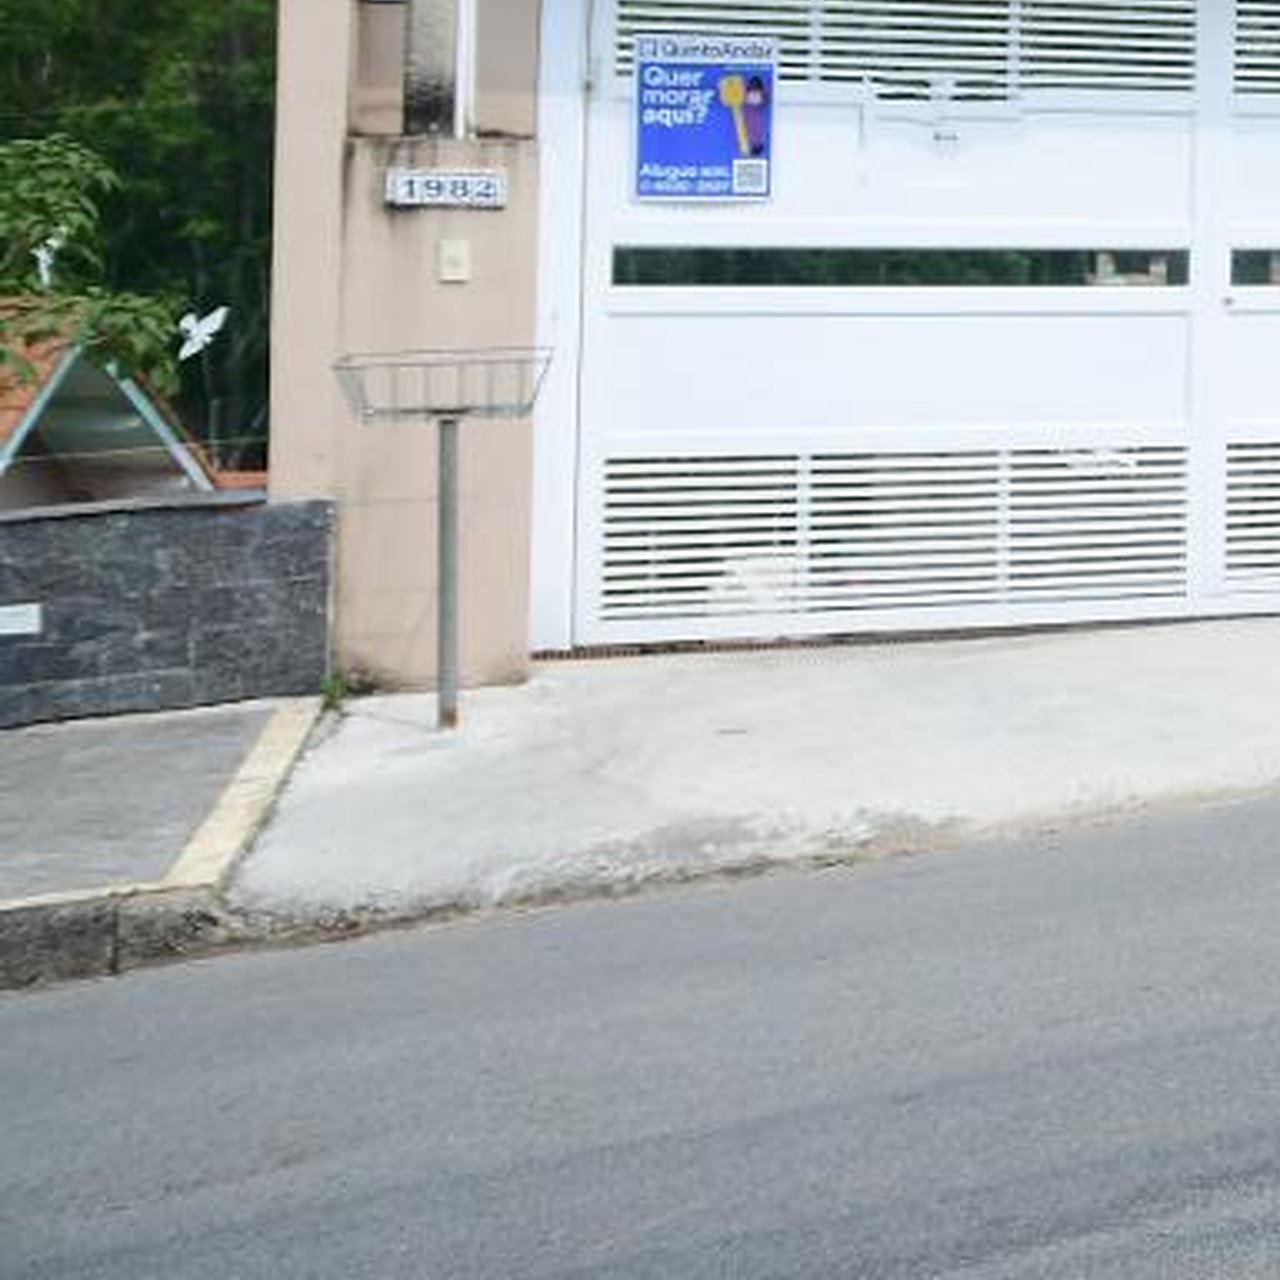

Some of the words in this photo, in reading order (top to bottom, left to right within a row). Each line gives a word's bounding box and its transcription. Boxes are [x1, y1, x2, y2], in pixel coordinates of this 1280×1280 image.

[643, 66, 704, 88] Quer
[643, 89, 715, 106] morar
[643, 106, 709, 128] aqui?
[406, 178, 496, 199] 1982
